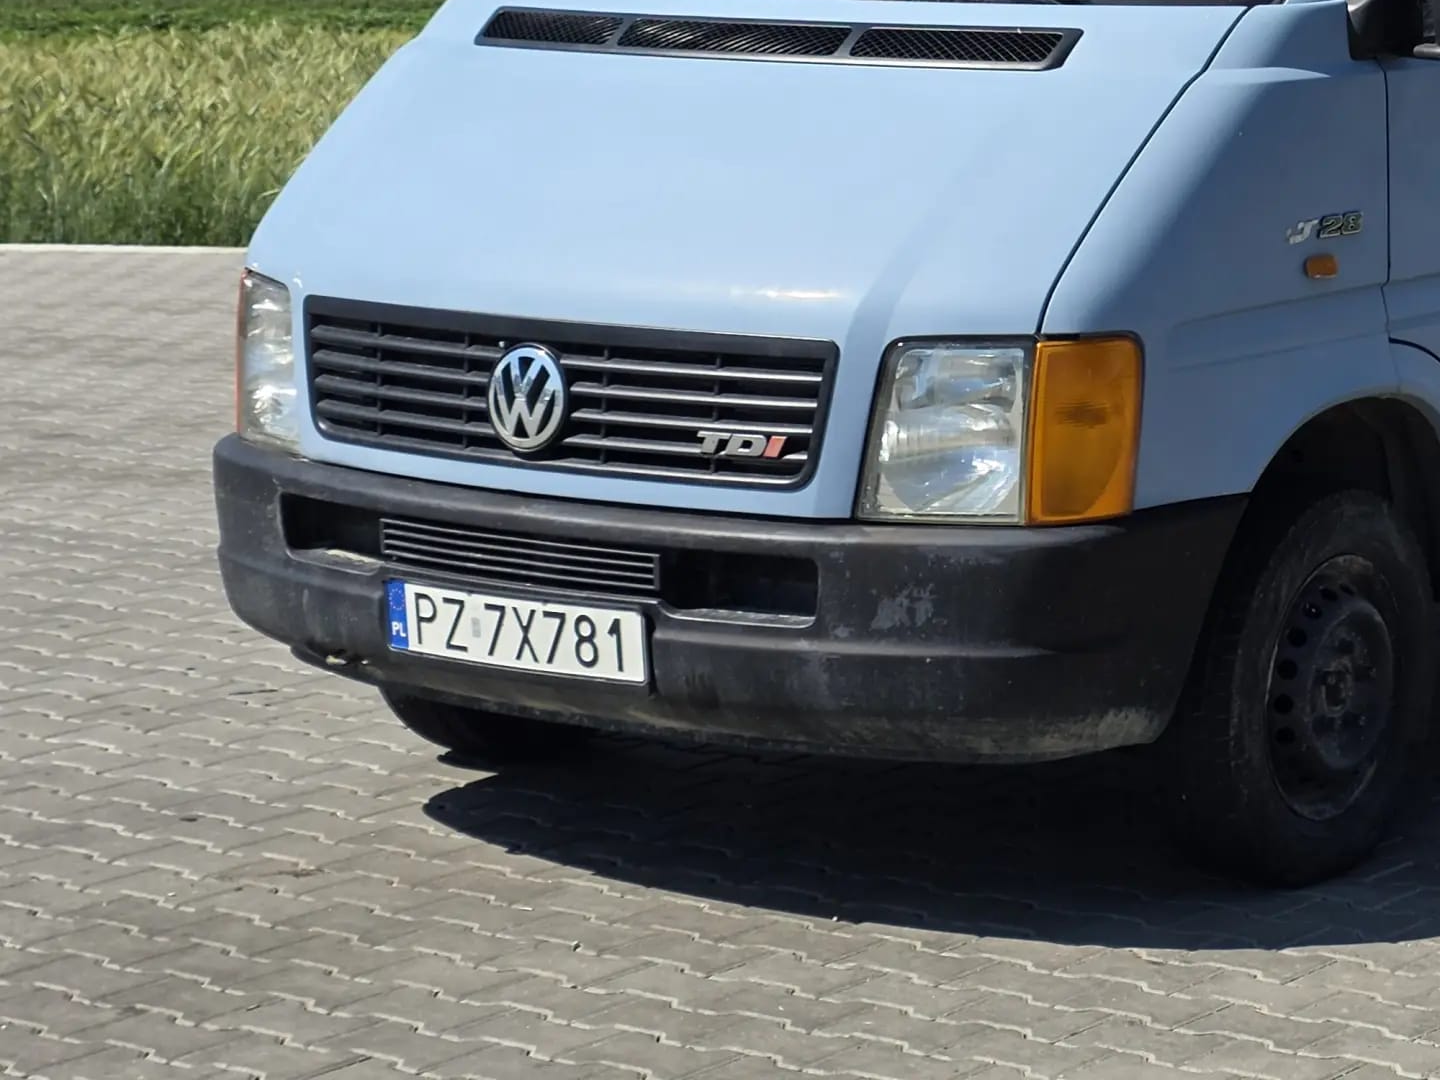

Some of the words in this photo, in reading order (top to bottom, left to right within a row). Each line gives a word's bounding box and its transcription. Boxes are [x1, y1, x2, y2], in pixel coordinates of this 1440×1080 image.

[391, 621, 407, 638] PL
[414, 592, 468, 653] PZ
[484, 603, 624, 672] 7X781
